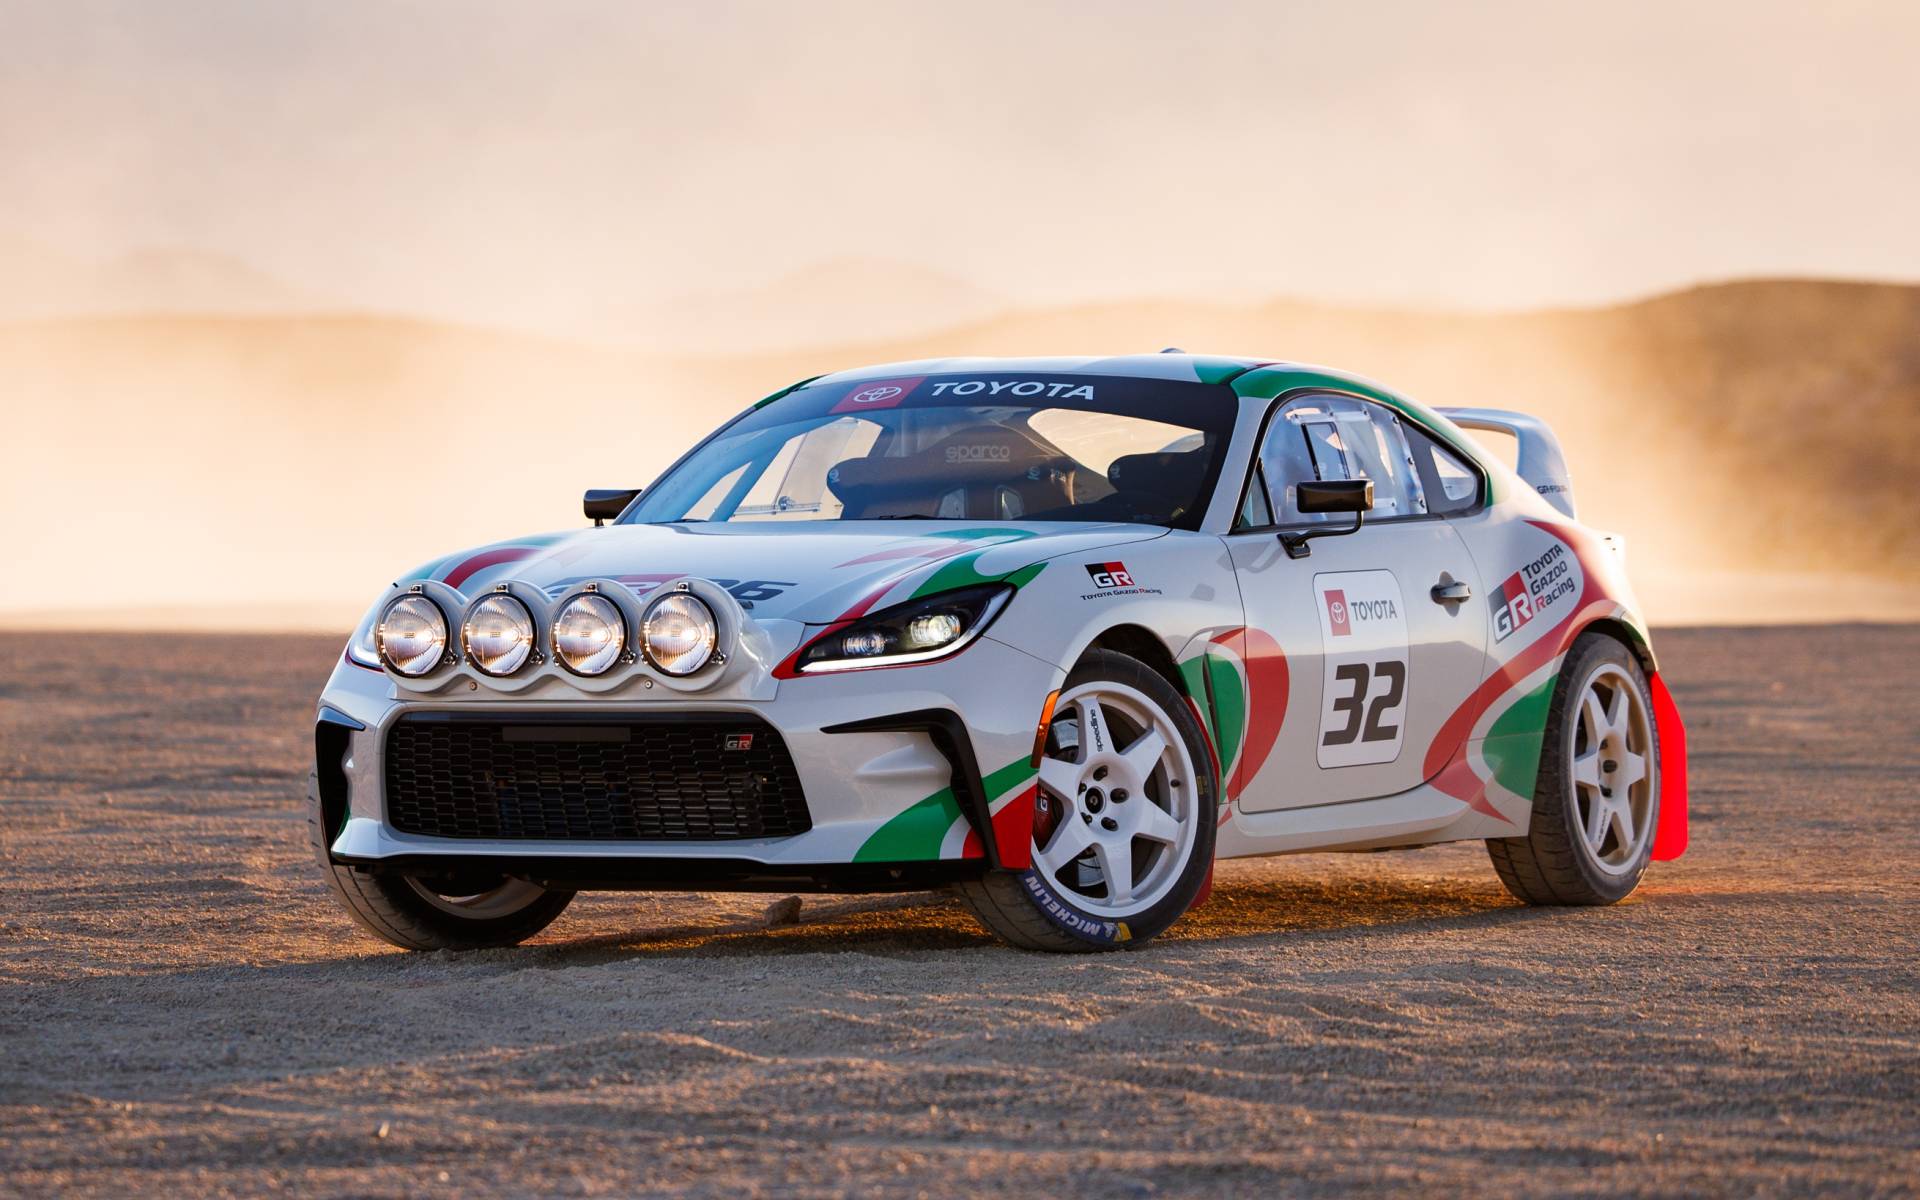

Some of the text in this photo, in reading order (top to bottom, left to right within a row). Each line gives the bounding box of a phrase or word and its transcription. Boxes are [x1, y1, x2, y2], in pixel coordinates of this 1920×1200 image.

[931, 381, 1094, 400] TOYOTA
[945, 445, 1010, 463] sparco
[1093, 571, 1133, 587] GR
[1522, 544, 1564, 579] TOYOTA
[1530, 560, 1568, 596] GAZOO
[1080, 592, 1113, 600] TOYOTA
[1139, 587, 1162, 595] Racing
[1351, 600, 1398, 621] TOYOTA
[1535, 577, 1575, 612] Racing
[1493, 592, 1532, 642] GR
[1322, 661, 1405, 746] 32
[1090, 709, 1104, 752] speedline
[1025, 876, 1101, 936] MICHELIN
